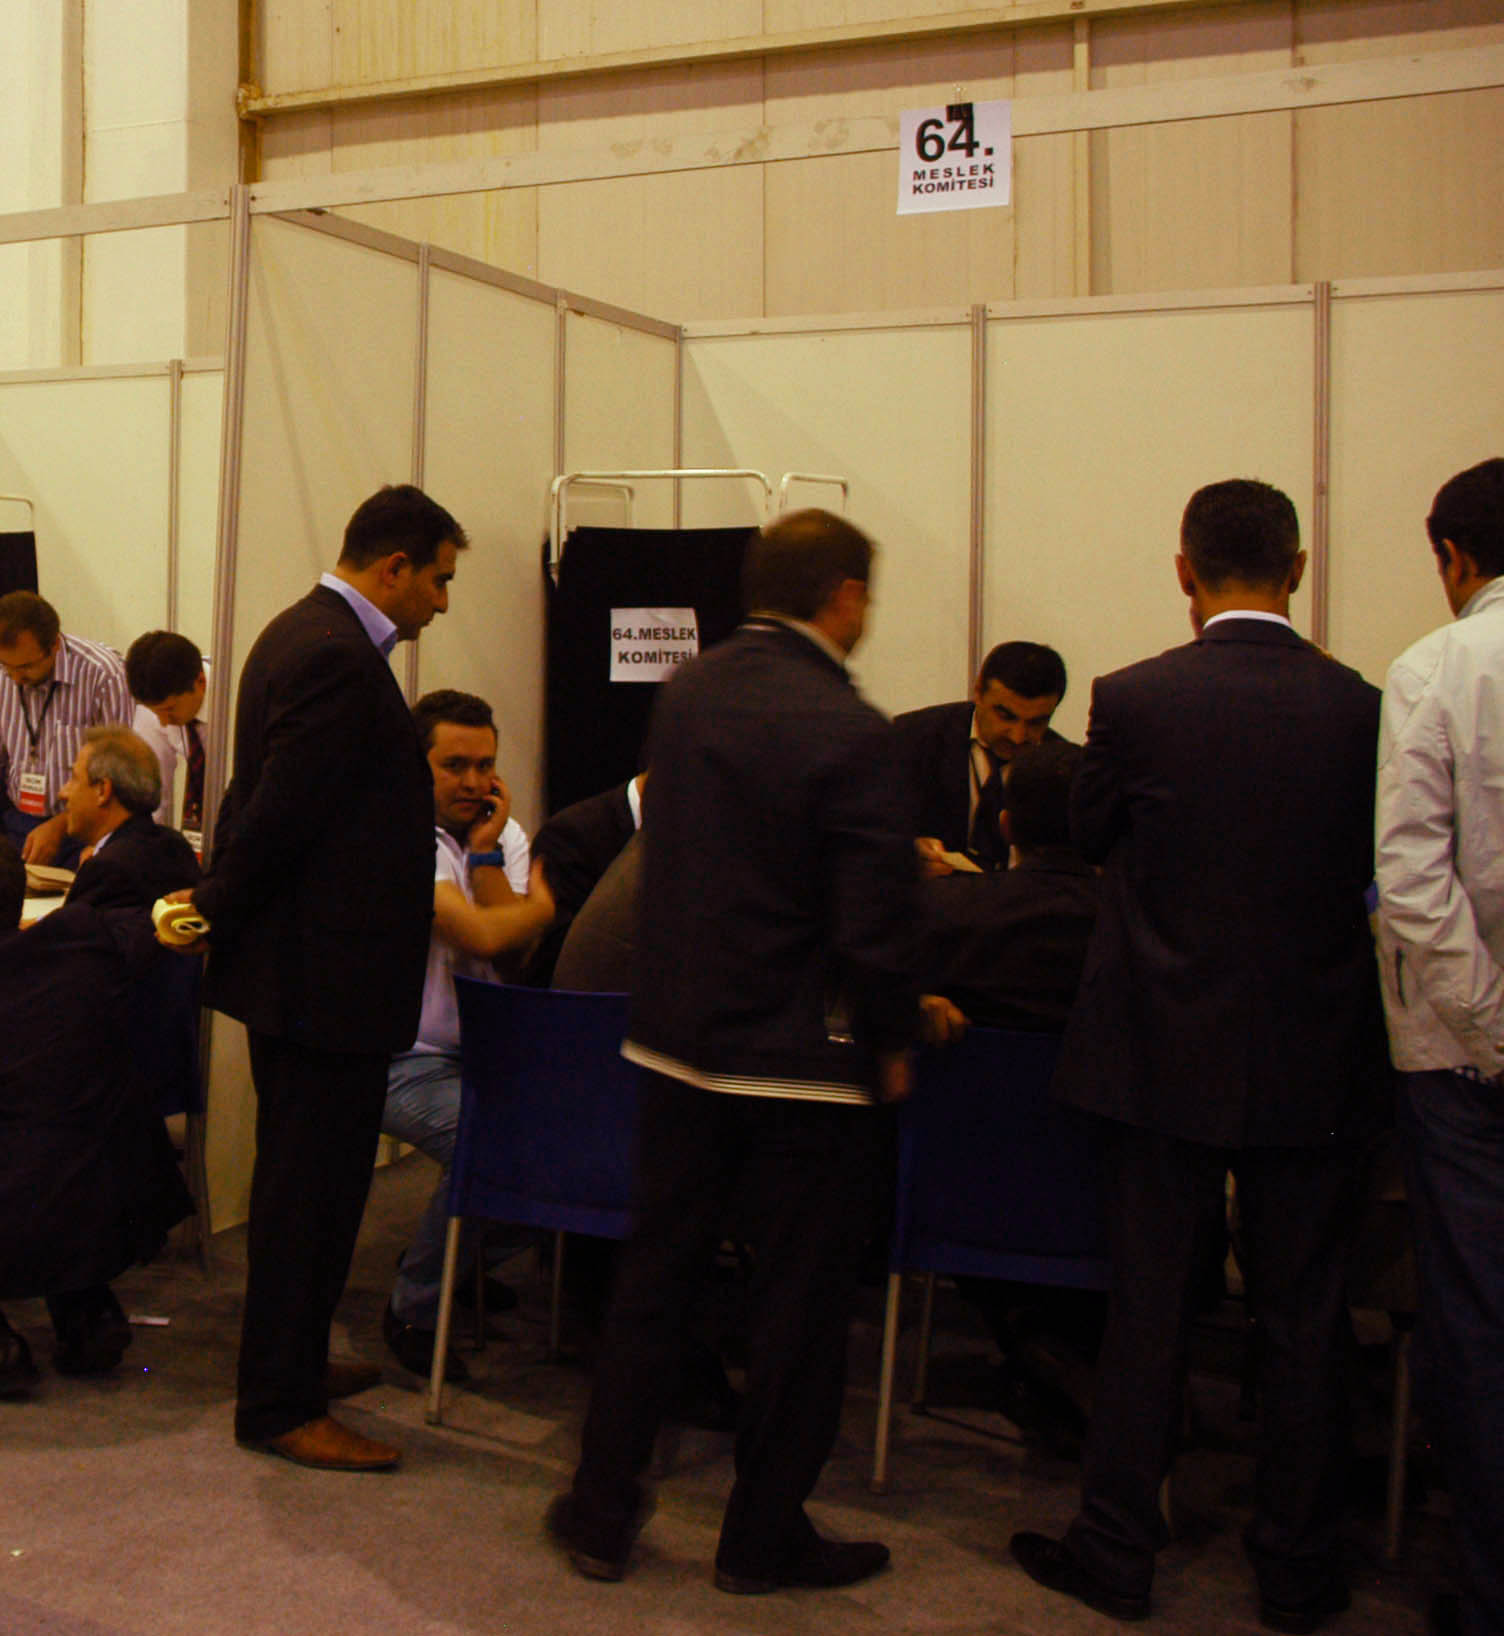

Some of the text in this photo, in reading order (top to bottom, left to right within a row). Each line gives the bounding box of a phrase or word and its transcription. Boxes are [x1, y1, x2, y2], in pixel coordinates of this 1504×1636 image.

[915, 115, 994, 163] 64.
[912, 163, 995, 181] MESLEK
[912, 175, 995, 195] KOMİTESİ
[612, 627, 697, 641] 64.MESLEK
[617, 647, 694, 665] KOMİTESİ
